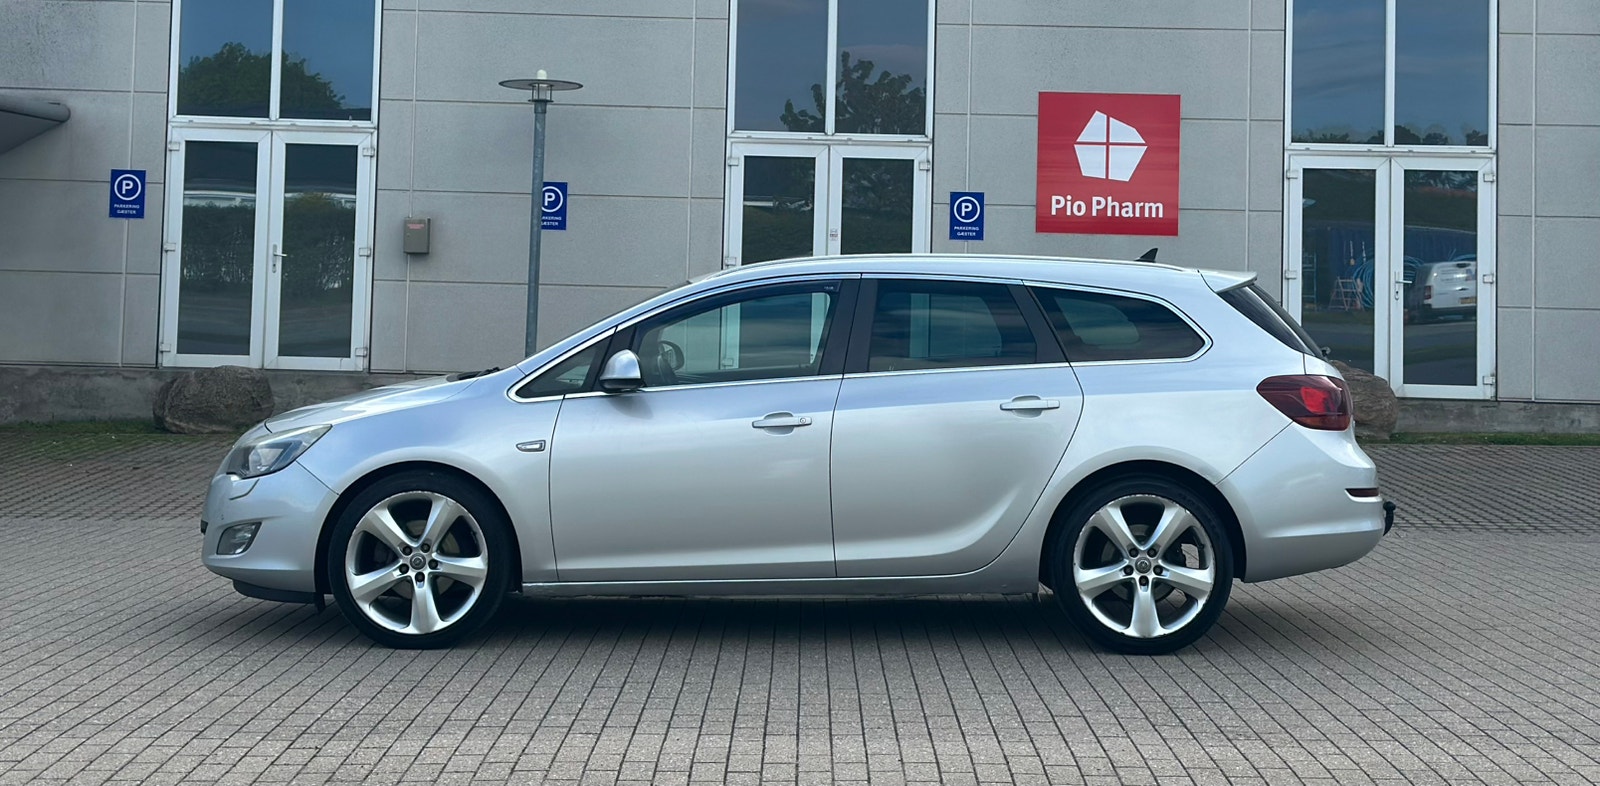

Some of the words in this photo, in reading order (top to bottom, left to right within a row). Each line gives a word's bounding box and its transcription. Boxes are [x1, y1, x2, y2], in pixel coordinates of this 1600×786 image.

[122, 180, 133, 194] P
[544, 192, 556, 206] P
[961, 202, 973, 216] P
[1051, 195, 1086, 217] Pio
[1092, 196, 1164, 218] Pharm
